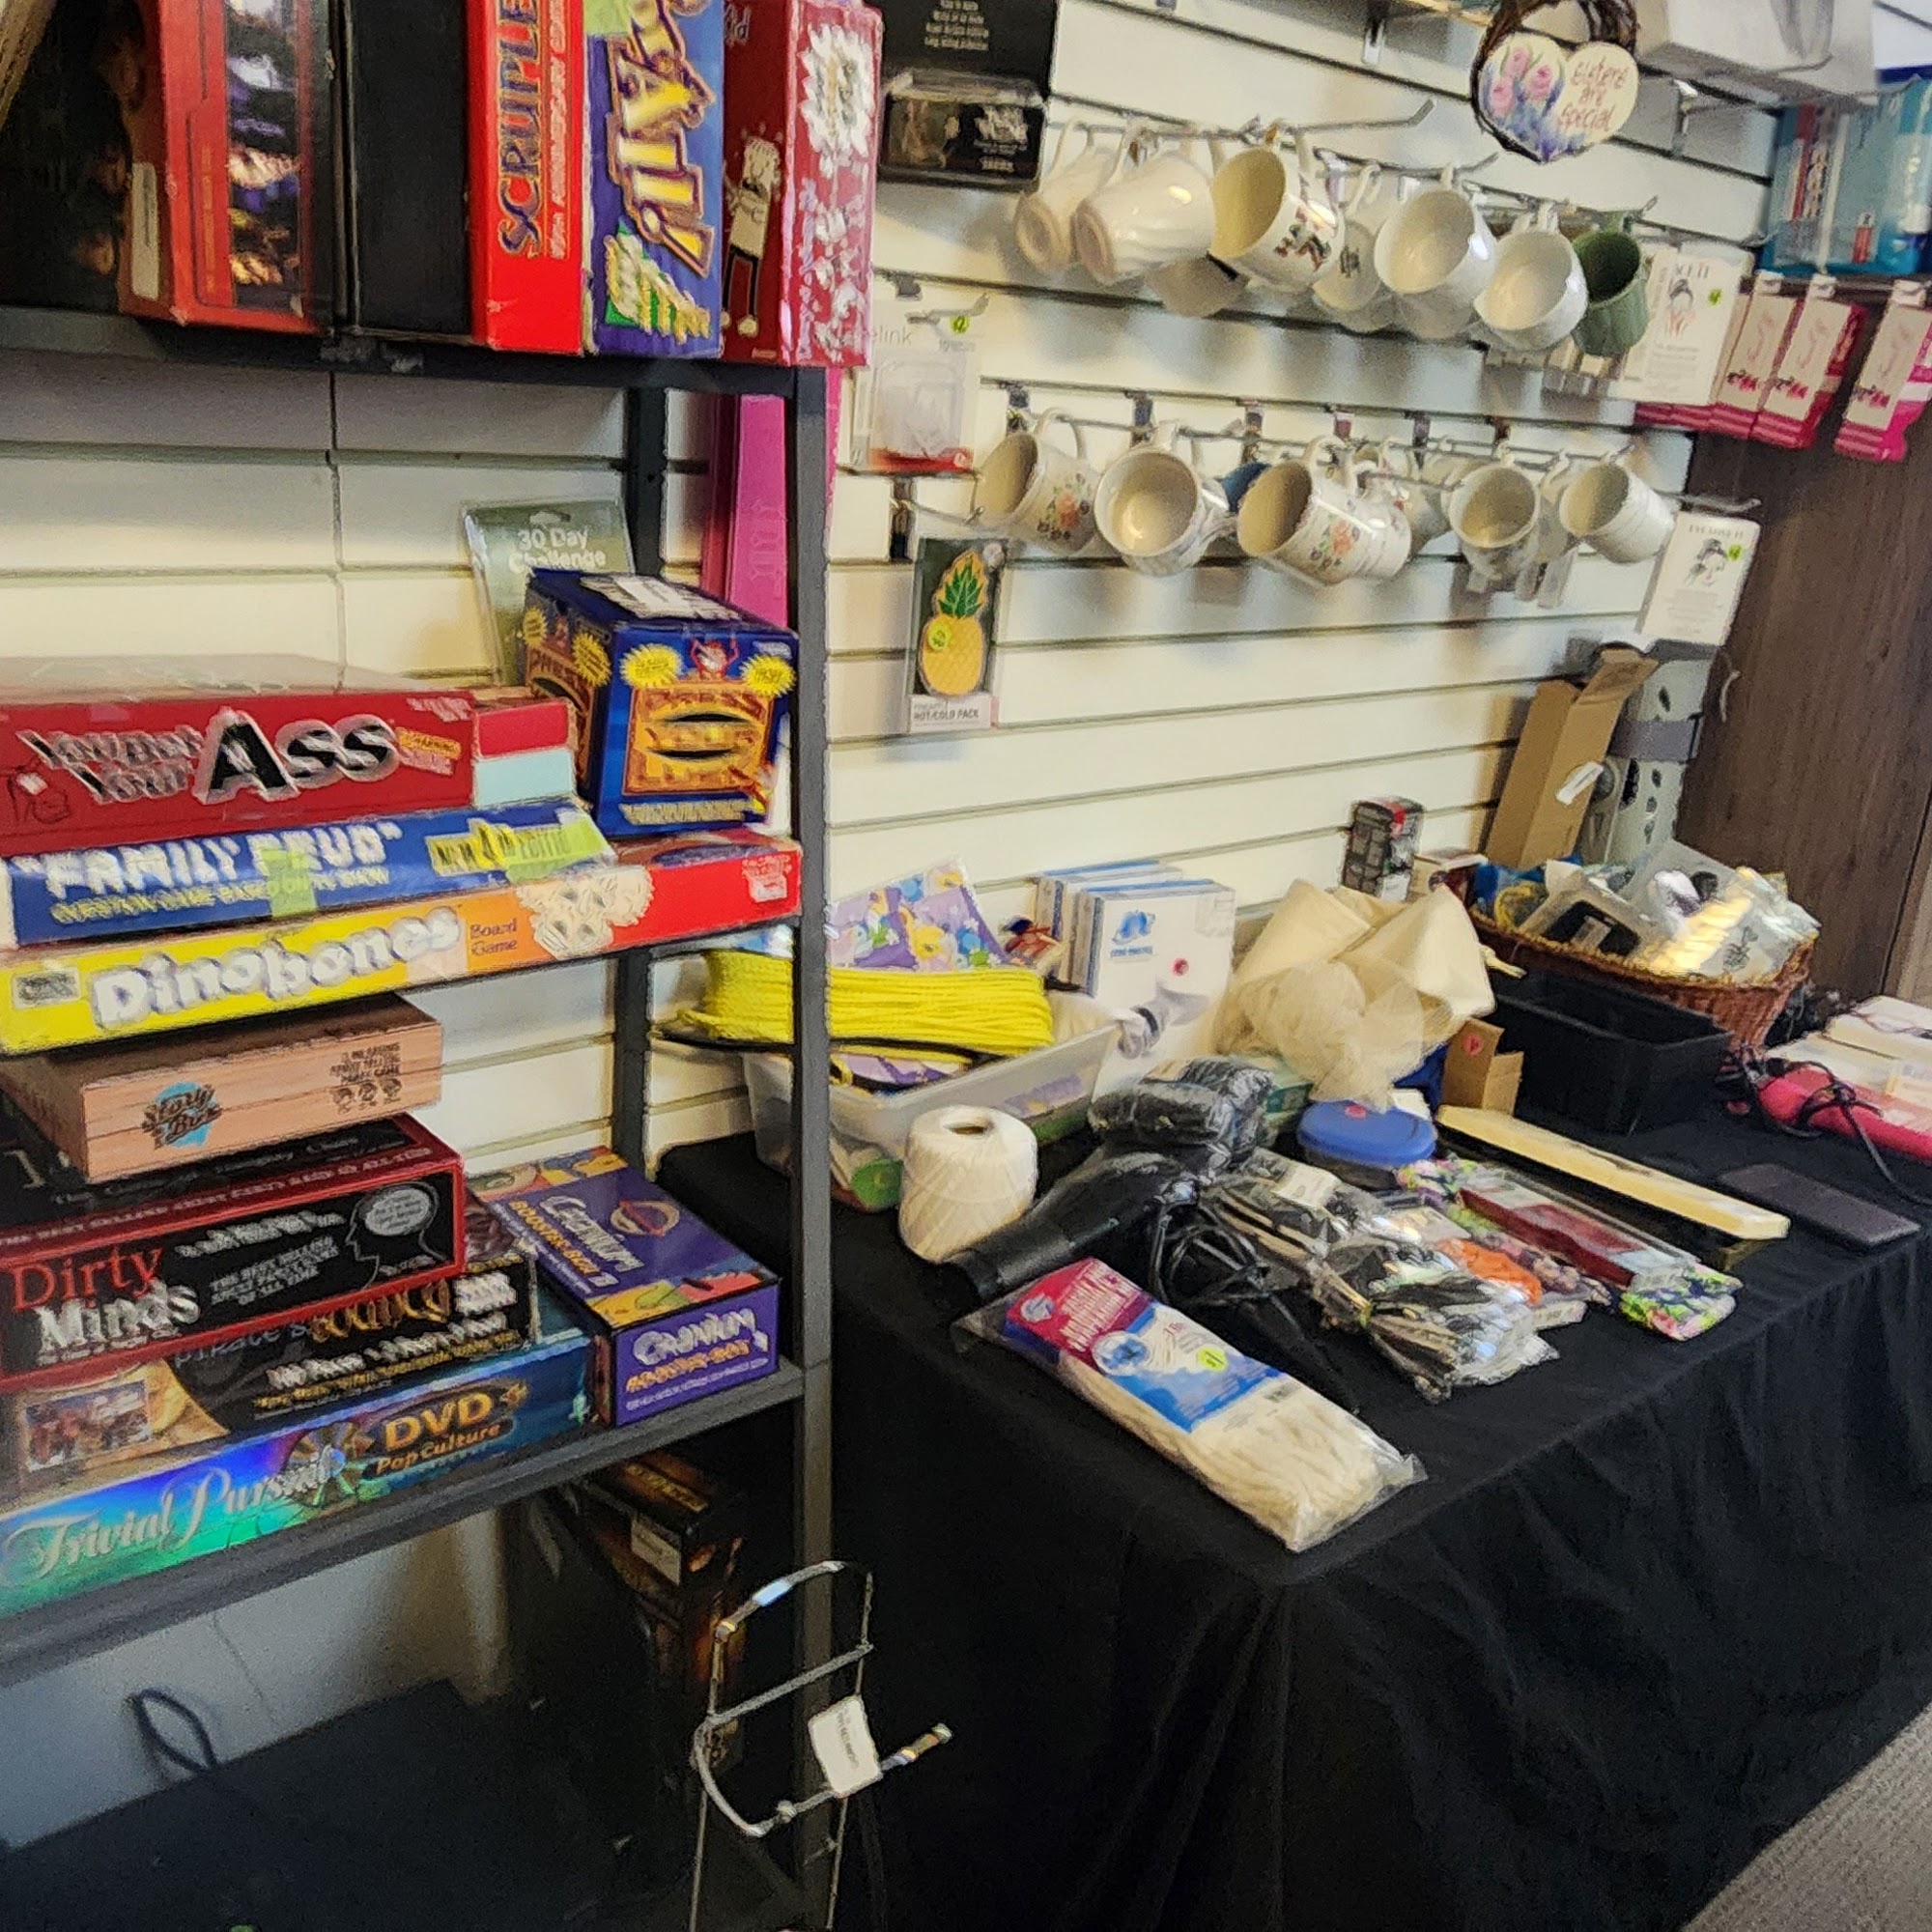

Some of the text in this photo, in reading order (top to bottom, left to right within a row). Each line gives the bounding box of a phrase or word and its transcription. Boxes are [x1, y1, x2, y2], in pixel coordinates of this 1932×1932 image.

[518, 526, 588, 551] 30 Day
[956, 707, 980, 721] PACK
[469, 917, 519, 941] Board
[470, 936, 519, 957] Game
[93, 906, 461, 1028] Dinobones
[12, 1246, 164, 1313] Dirty
[384, 1391, 493, 1452] DVD
[376, 1422, 503, 1476] Pop Culture
[4, 1487, 175, 1585] Trivial
